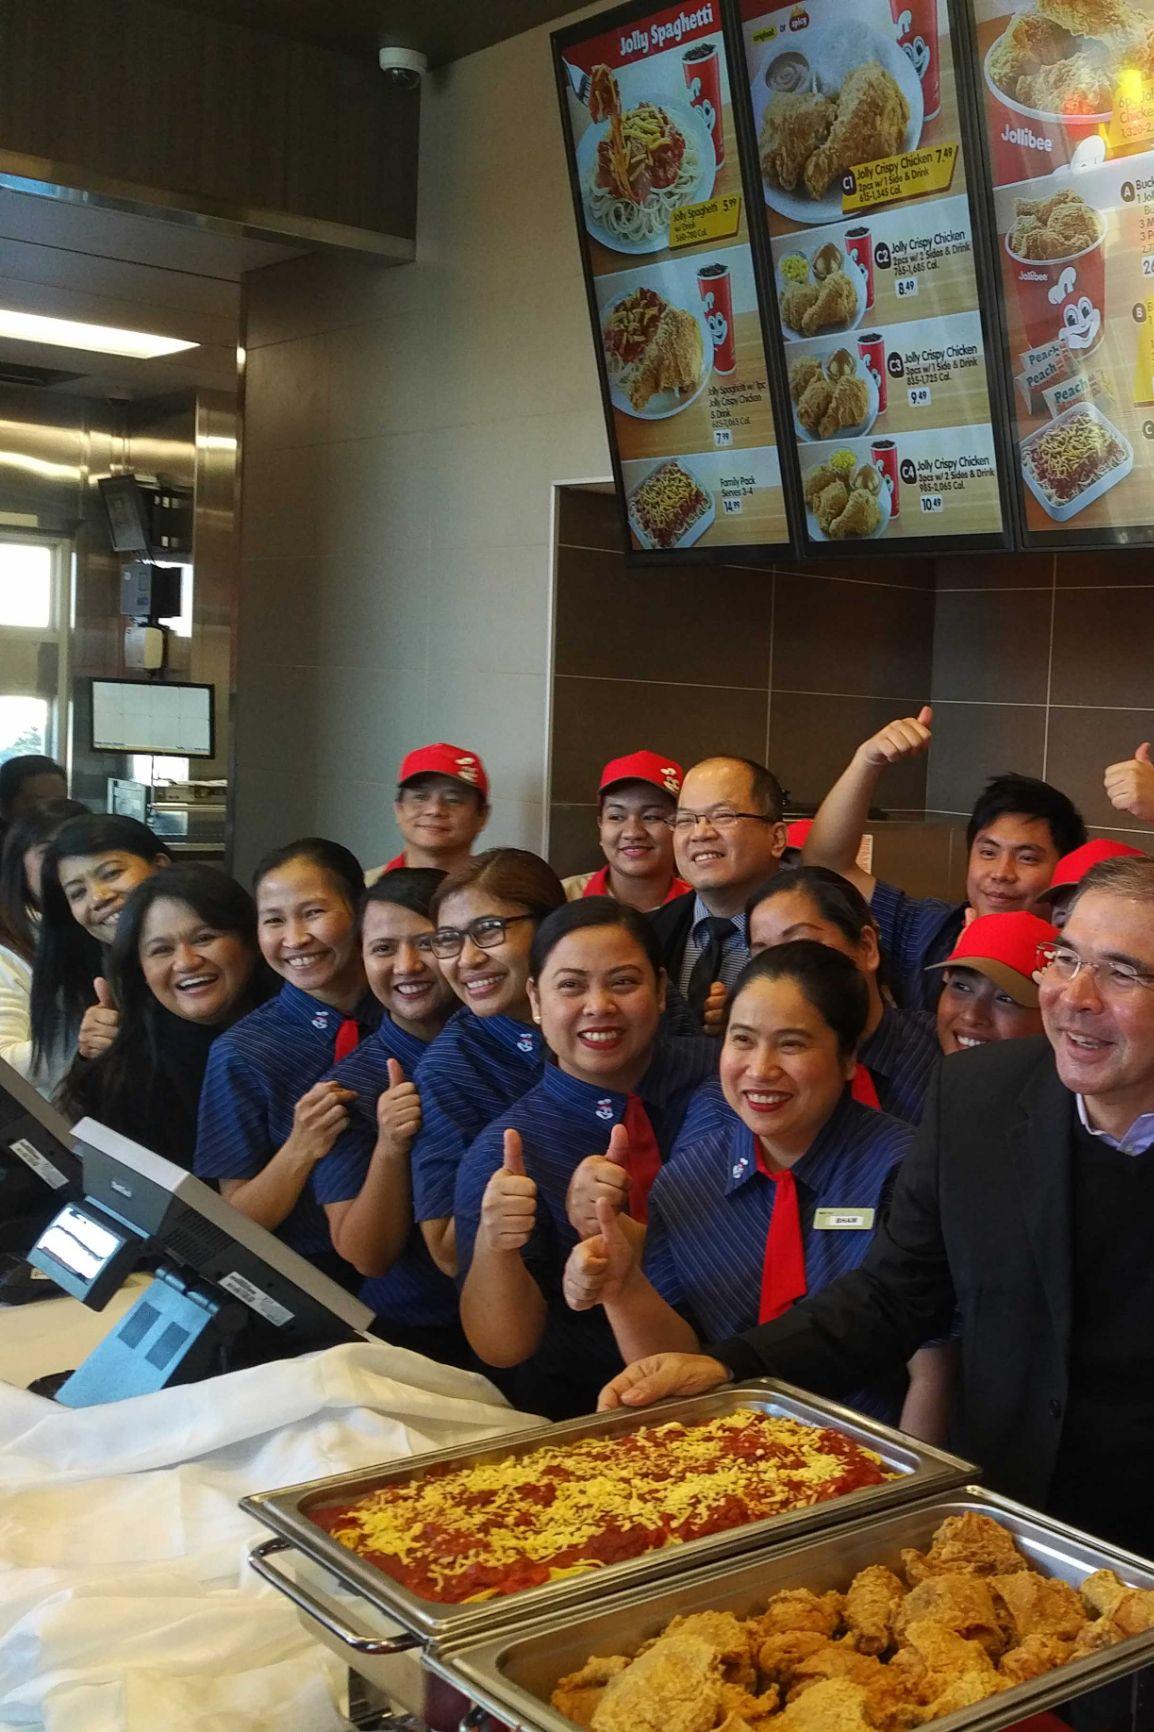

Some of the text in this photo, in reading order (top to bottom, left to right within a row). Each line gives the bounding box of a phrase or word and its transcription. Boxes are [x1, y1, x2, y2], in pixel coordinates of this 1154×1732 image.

[620, 30, 649, 56] Jolly
[650, 3, 713, 47] Spaghetti
[1001, 124, 1053, 152] Jollibee
[857, 147, 953, 180] Jolly Crispy Chicken 7.49
[911, 168, 930, 180] Drink
[842, 176, 854, 189] C1
[1124, 186, 1132, 198] A
[1139, 219, 1145, 229] 3
[891, 230, 966, 255] Jolly Crispy Chicken
[1140, 231, 1146, 241] 3
[952, 242, 971, 254] Drink
[876, 250, 890, 263] C2
[1018, 270, 1048, 281] Jollibee
[898, 281, 915, 295] 8.49
[904, 344, 978, 364] Jolly Crispy Chicken
[1028, 346, 1059, 365] Peach
[889, 361, 902, 372] C3
[960, 358, 978, 368] Drink
[1026, 363, 1057, 387] Peach
[911, 390, 927, 404] 9.49
[1054, 378, 1089, 404] Peach
[1146, 424, 1153, 434] C
[917, 455, 990, 472] Jolly Crispy Chicken
[976, 468, 996, 477] Drink
[922, 498, 942, 511] 10.49
